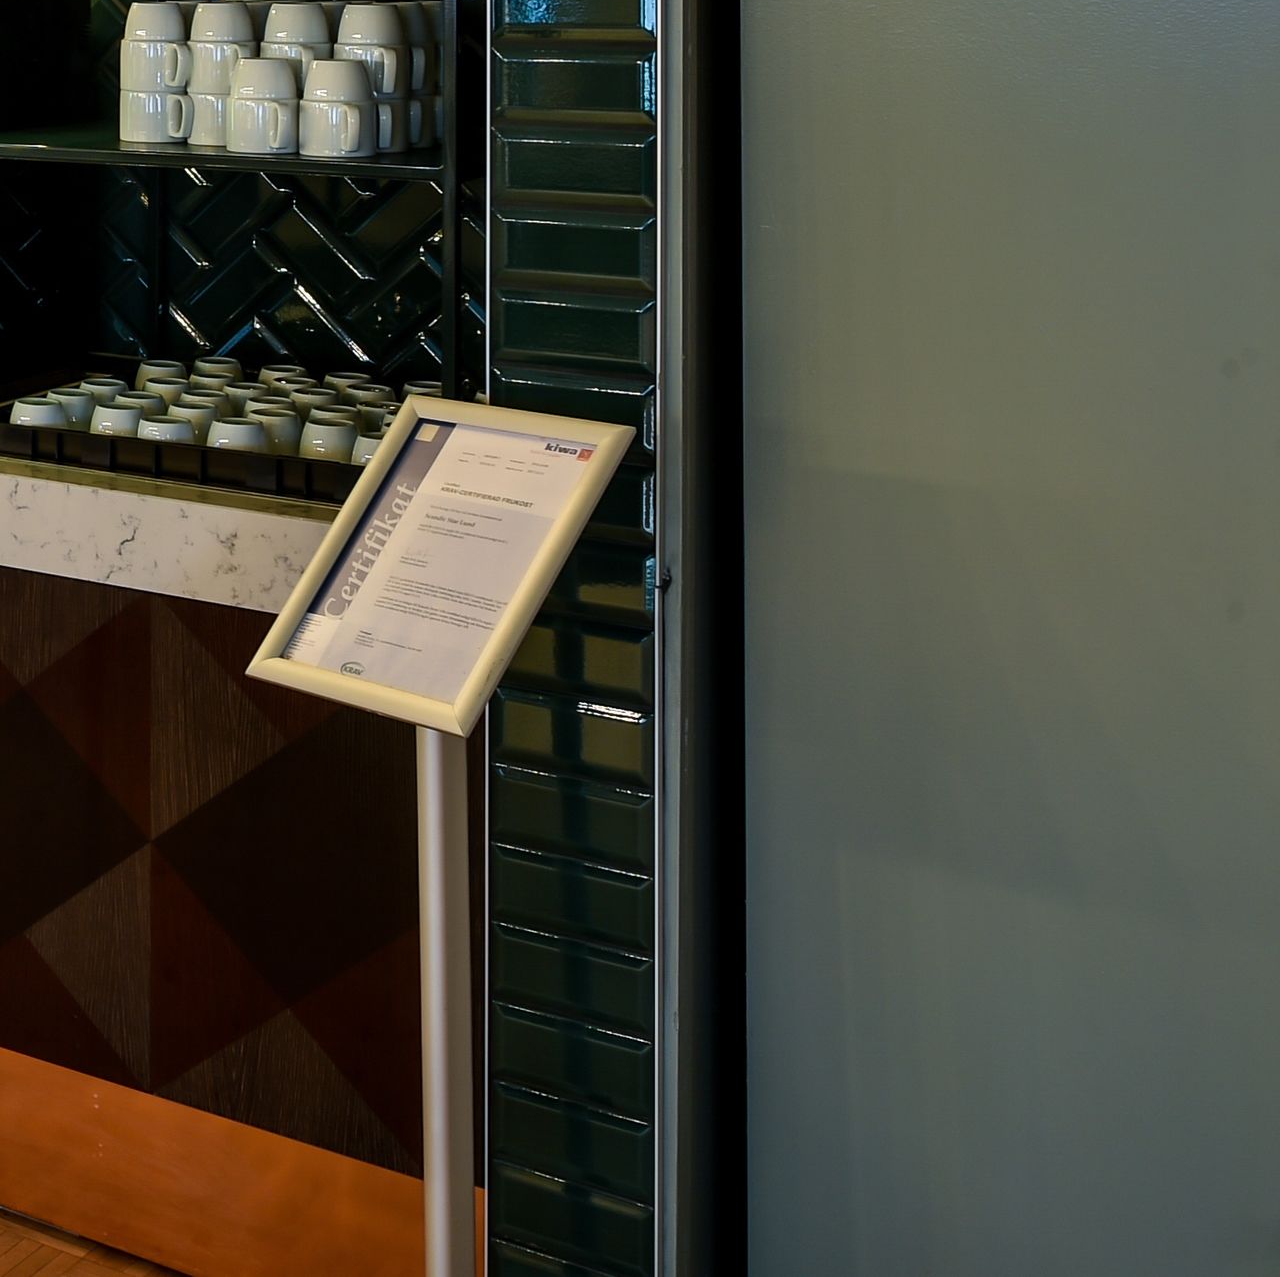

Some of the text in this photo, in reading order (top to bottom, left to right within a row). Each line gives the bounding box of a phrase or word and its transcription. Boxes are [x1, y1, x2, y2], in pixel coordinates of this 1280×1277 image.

[544, 442, 578, 456] kiwa
[501, 497, 535, 509] FRUKOST
[324, 482, 417, 621] Certifikat
